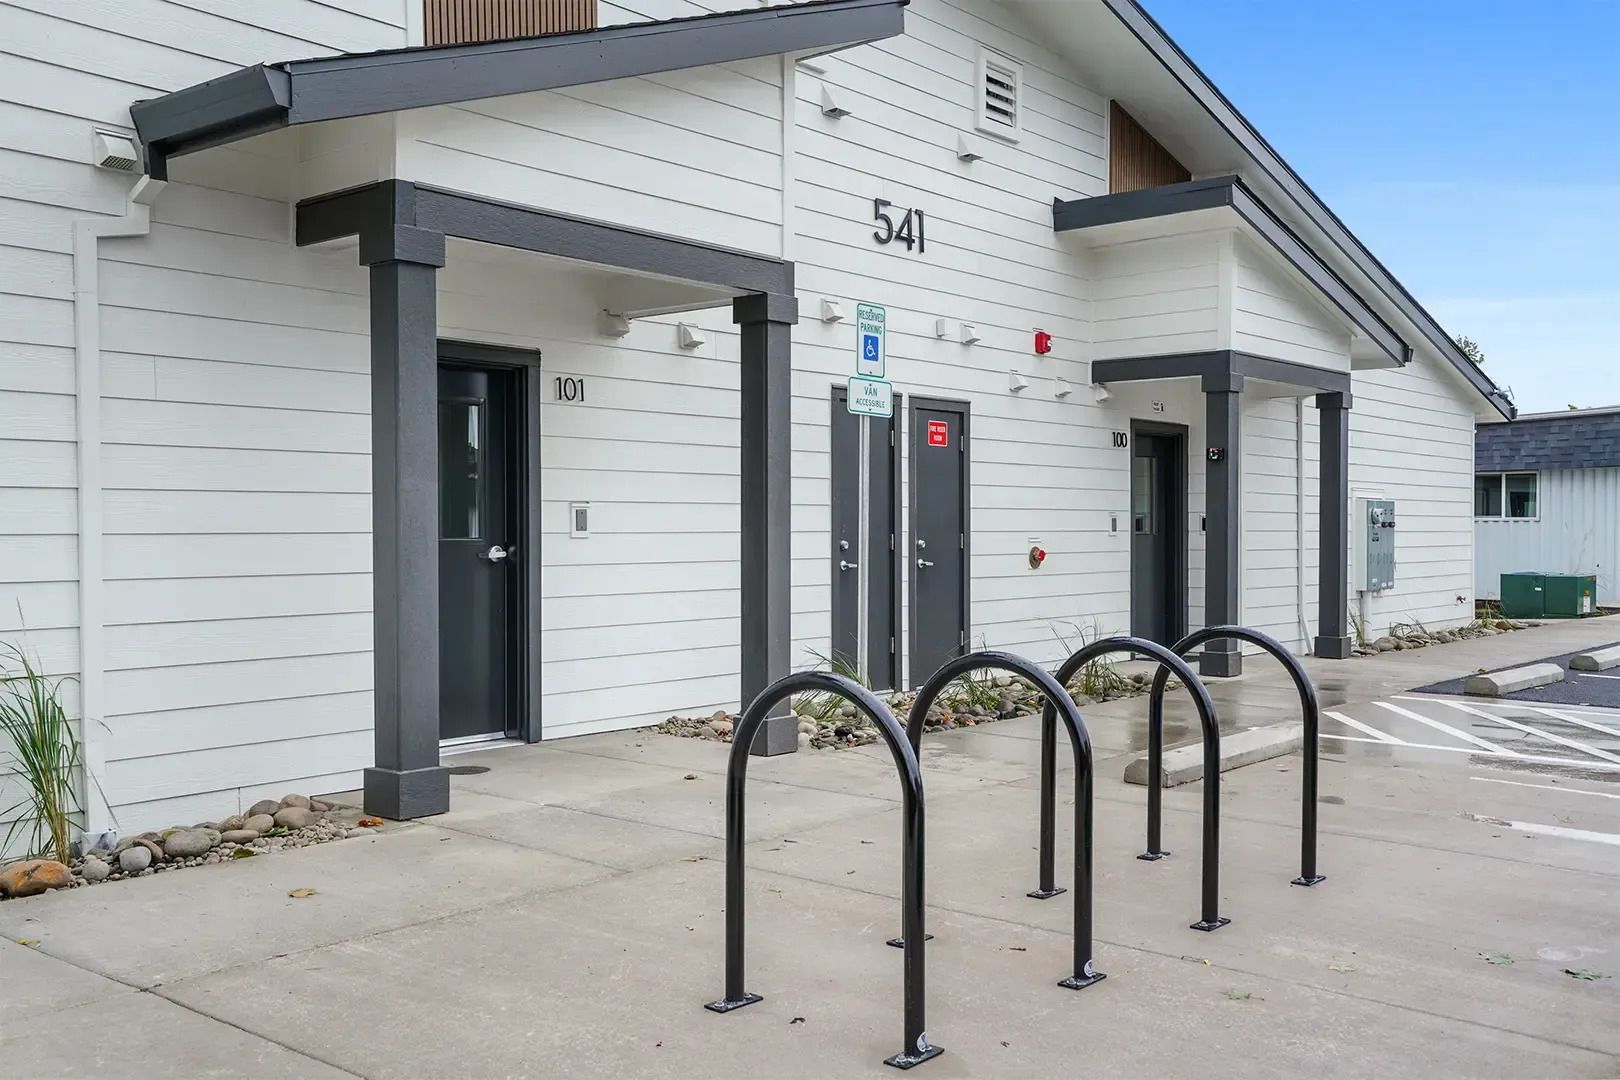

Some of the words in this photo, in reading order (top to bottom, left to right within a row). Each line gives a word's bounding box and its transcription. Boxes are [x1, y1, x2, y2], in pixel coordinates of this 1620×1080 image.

[873, 198, 925, 253] 541
[859, 309, 884, 323] RESERVED
[860, 322, 883, 335] PARKING
[555, 376, 585, 402] 101
[864, 386, 878, 397] VAN
[856, 398, 886, 409] ACCESSIBLE
[1111, 431, 1128, 448] 100
